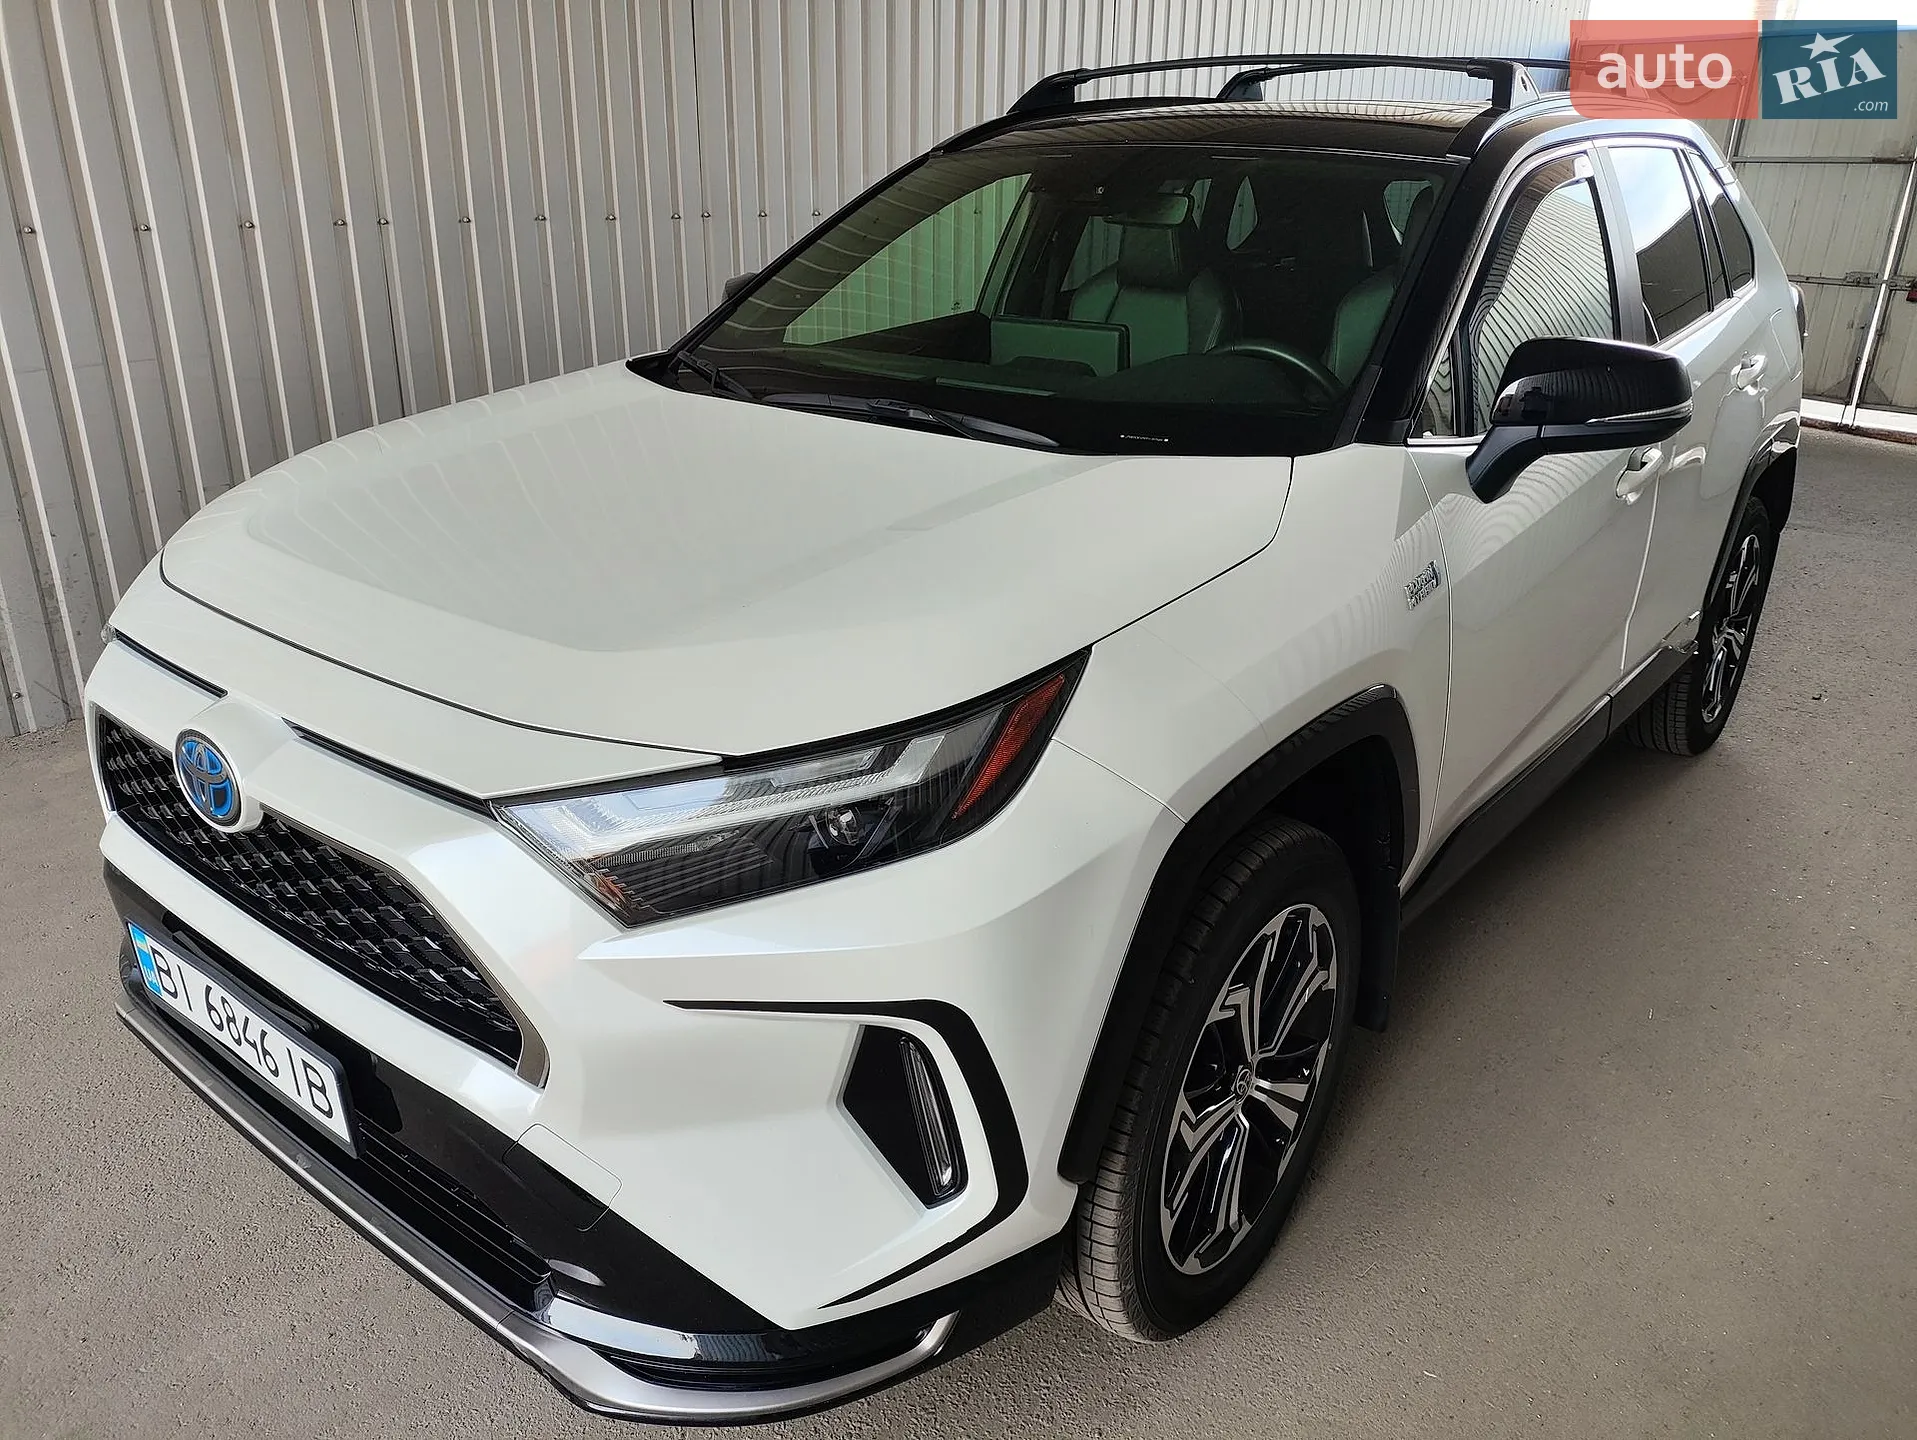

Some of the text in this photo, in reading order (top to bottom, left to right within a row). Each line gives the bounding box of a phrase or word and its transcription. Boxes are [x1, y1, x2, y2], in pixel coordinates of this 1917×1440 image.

[149, 945, 334, 1119] BI 6846 IB
